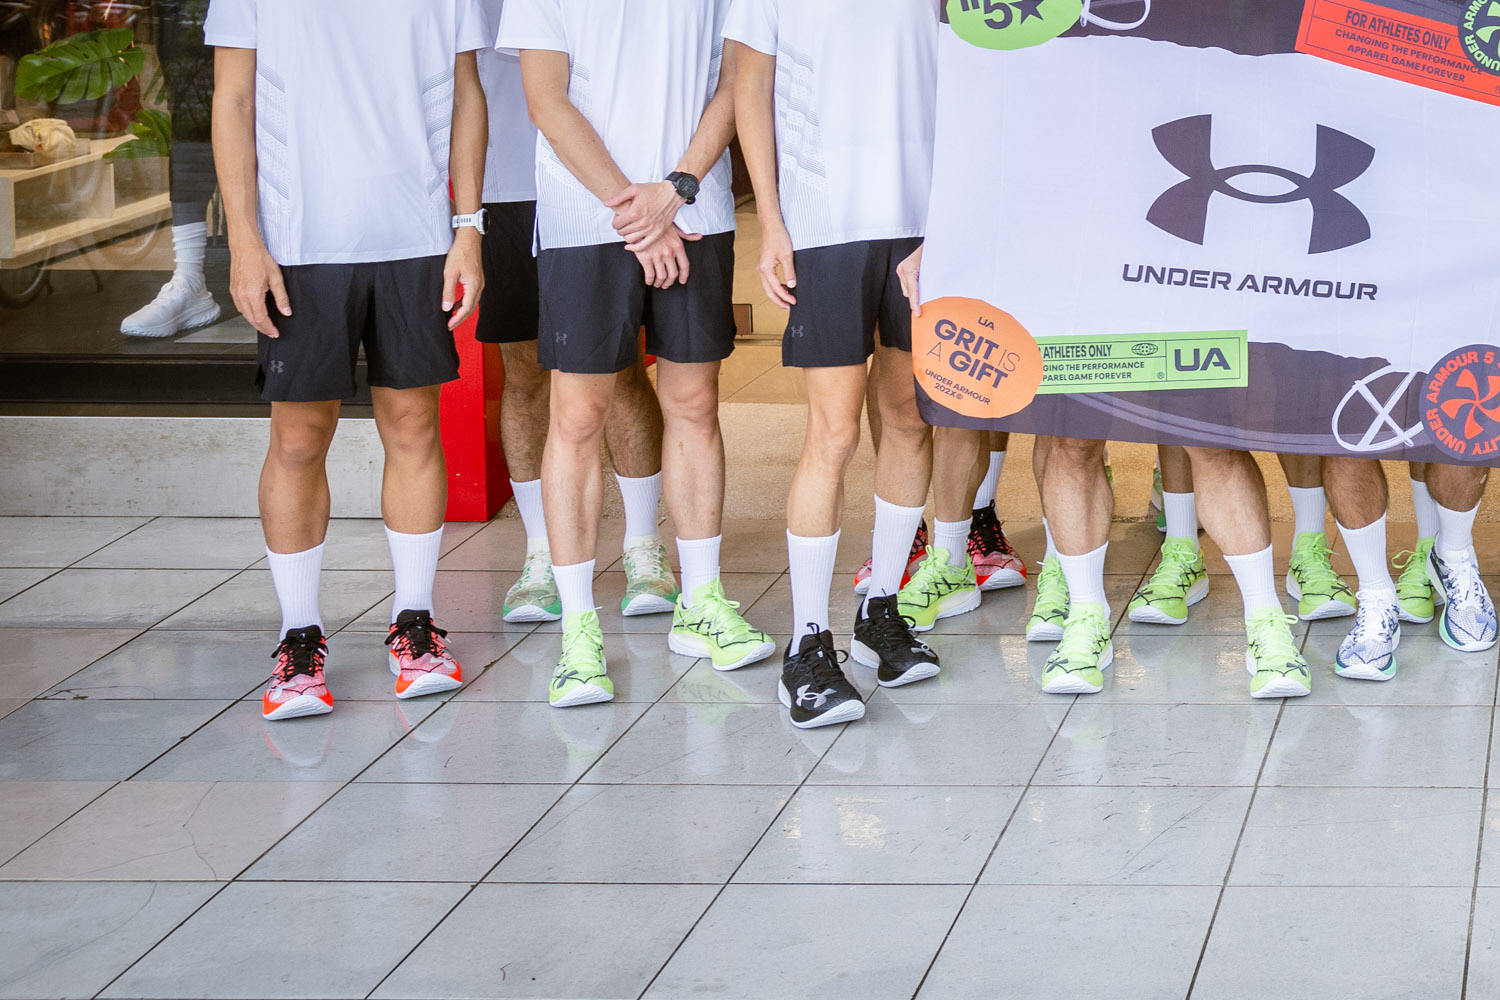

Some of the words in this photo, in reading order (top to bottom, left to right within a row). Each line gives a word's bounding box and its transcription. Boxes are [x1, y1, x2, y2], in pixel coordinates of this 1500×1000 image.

[1345, 10, 1368, 28] FOR
[1368, 17, 1421, 43] ATHLETES
[1422, 31, 1451, 51] ONLY
[1335, 28, 1389, 49] CHANGING
[1391, 44, 1409, 56] THE
[1410, 49, 1483, 75] PERFORMANCE
[1347, 44, 1390, 63] APPAREL
[1391, 56, 1420, 71] GAME
[1421, 64, 1465, 82] FOREVER
[1464, 34, 1500, 71] UNDER
[1122, 263, 1232, 290] UNDER
[1236, 274, 1378, 301] ARMOUR
[978, 316, 995, 331] UA
[934, 319, 999, 360] GRIT
[998, 348, 1020, 372] IS
[1043, 345, 1087, 359] ATHLETES
[1088, 344, 1112, 357] ONLY
[1174, 347, 1231, 372] UA
[1483, 351, 1495, 364] 5
[926, 341, 942, 362] A
[949, 350, 1009, 389] GIFT
[1066, 363, 1080, 371] THE
[1082, 361, 1145, 371] PERFORMANCE
[1068, 373, 1094, 381] GAME
[1094, 372, 1132, 380] FOREVER
[1426, 351, 1478, 403] ARMOUR
[925, 368, 953, 387] UNDER
[953, 383, 991, 405] ARMOUR
[1426, 408, 1467, 454] UNDER
